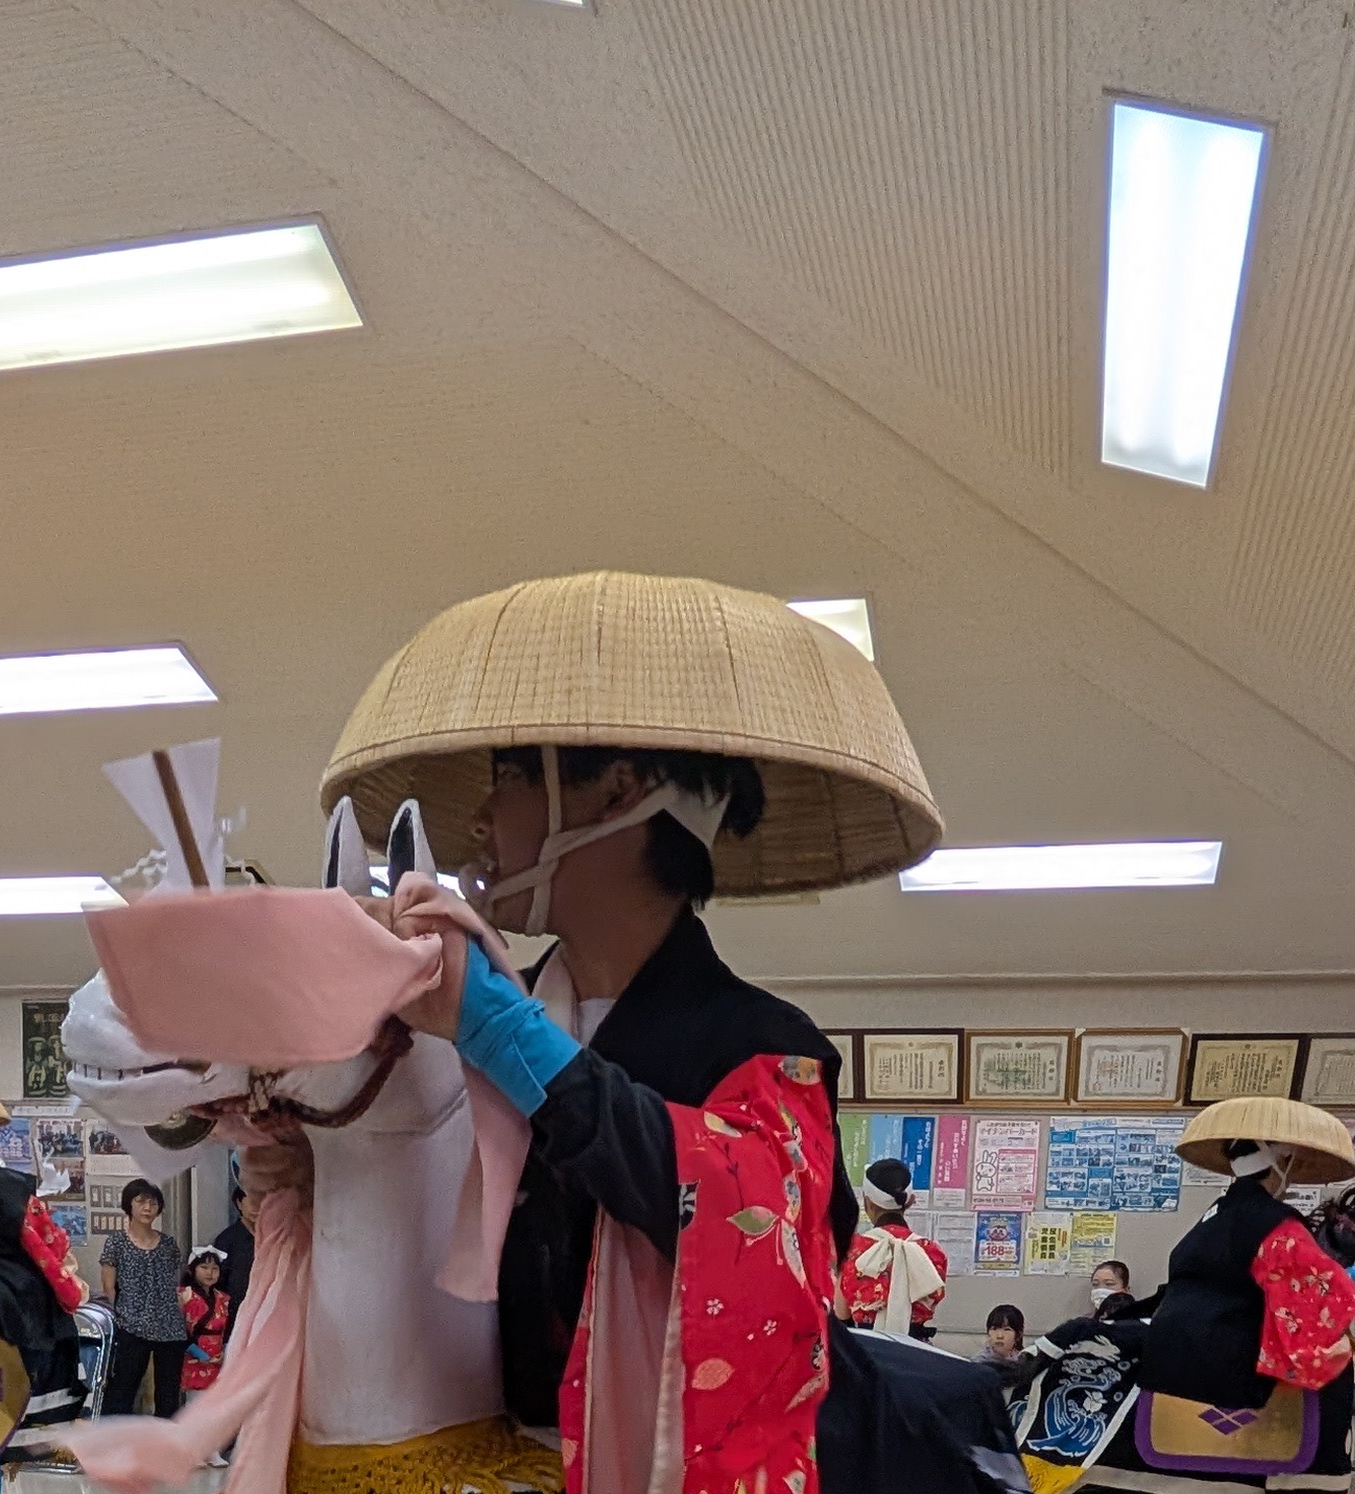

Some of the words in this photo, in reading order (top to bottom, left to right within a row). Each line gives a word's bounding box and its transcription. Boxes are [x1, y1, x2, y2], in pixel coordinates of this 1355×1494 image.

[980, 1127, 1037, 1136] マイナンバーカード
[986, 1246, 1005, 1256] 188
